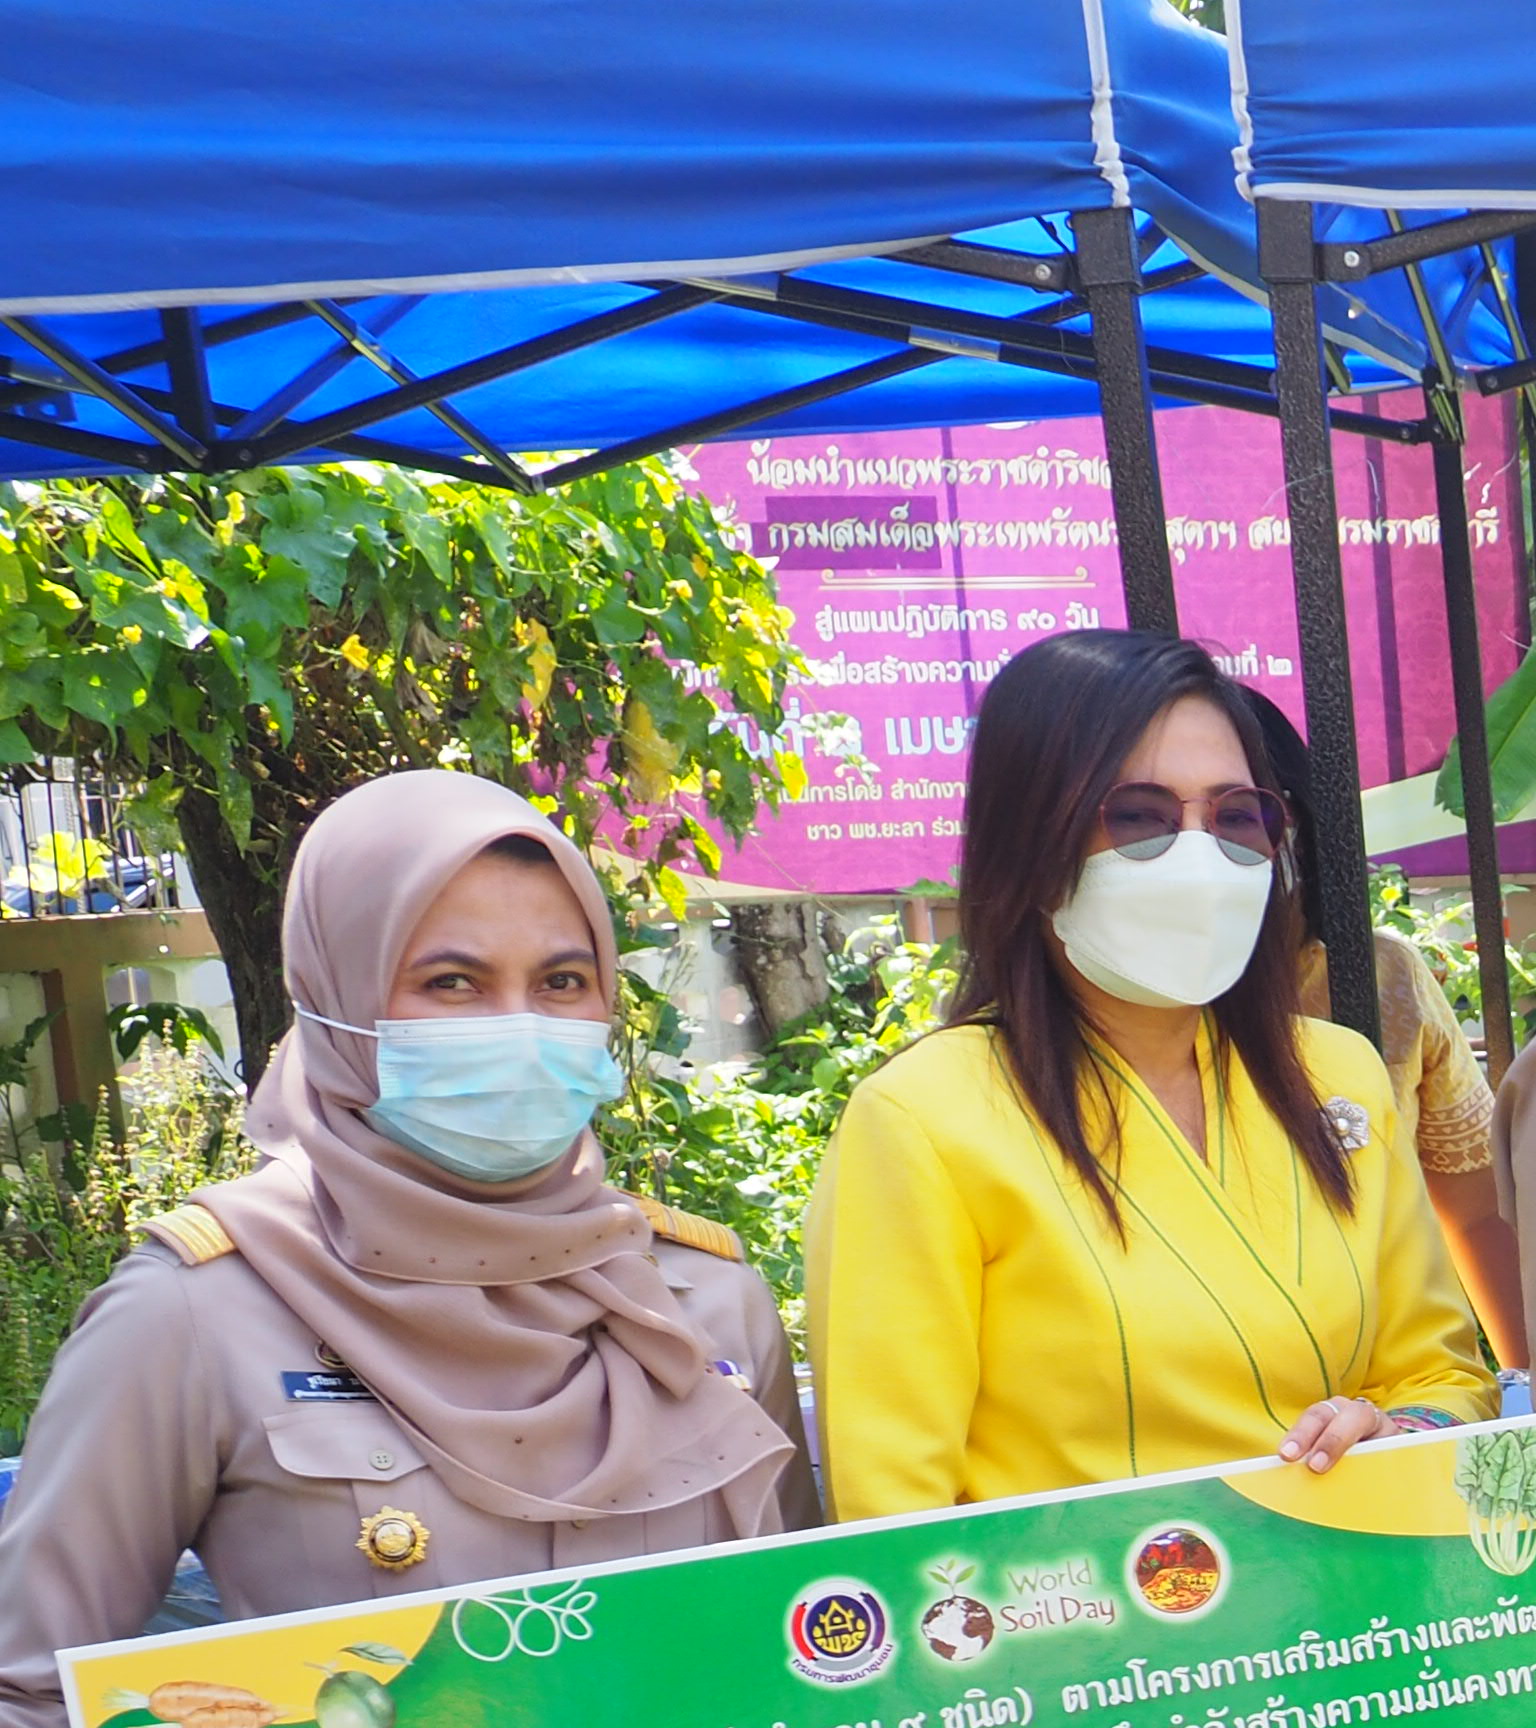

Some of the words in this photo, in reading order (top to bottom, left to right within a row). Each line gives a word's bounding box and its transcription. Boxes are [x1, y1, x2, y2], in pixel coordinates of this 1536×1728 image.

[815, 604, 1008, 641] สู่แผนปฏิบัติการ
[1017, 609, 1056, 630] ๙๐
[1065, 602, 1099, 630] วัน
[1266, 653, 1293, 676] ๒
[806, 822, 842, 840] ชาว
[849, 820, 925, 840] พช.ยะลา
[1007, 1558, 1093, 1595] World
[1000, 1602, 1053, 1633] Soil
[1060, 1596, 1116, 1630] Day
[791, 1642, 894, 1684] กรมการพัฒนาชุมชน
